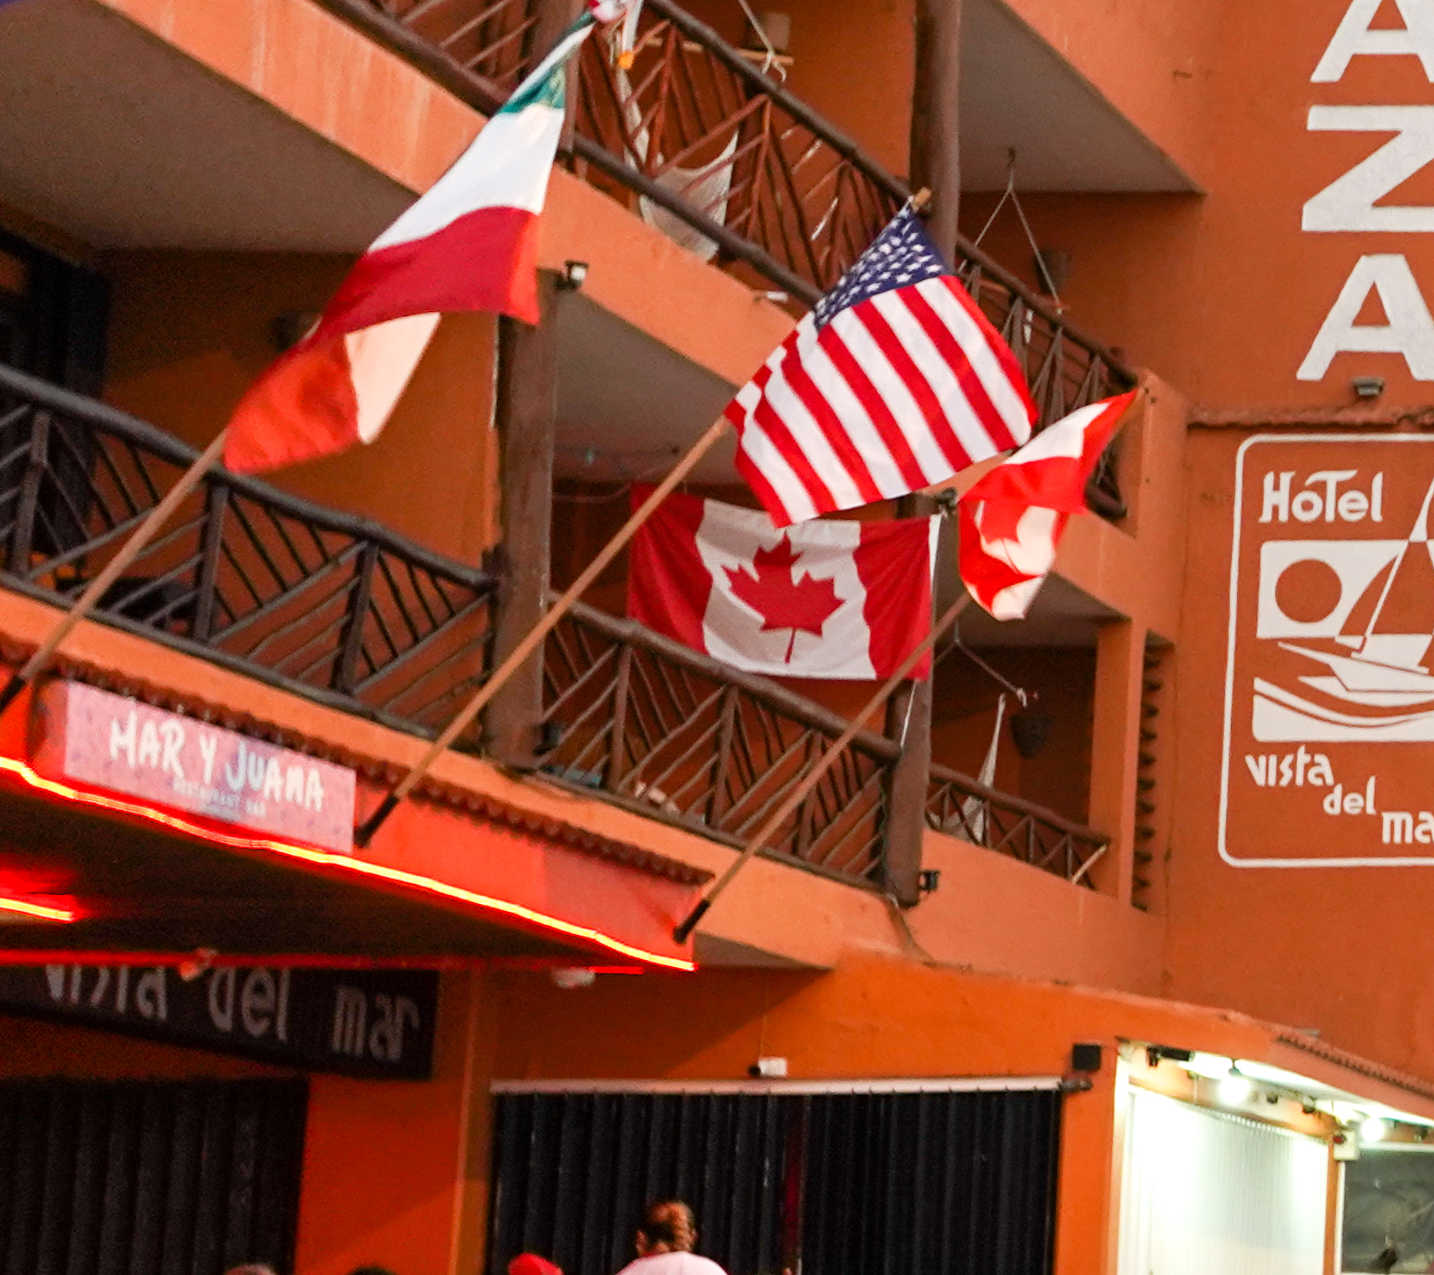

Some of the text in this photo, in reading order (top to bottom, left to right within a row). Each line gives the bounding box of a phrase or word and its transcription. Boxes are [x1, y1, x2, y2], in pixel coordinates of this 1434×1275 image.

[200, 734, 217, 784] Y
[1245, 744, 1334, 787] vista
[1323, 775, 1377, 815] del
[331, 984, 420, 1063] mar
